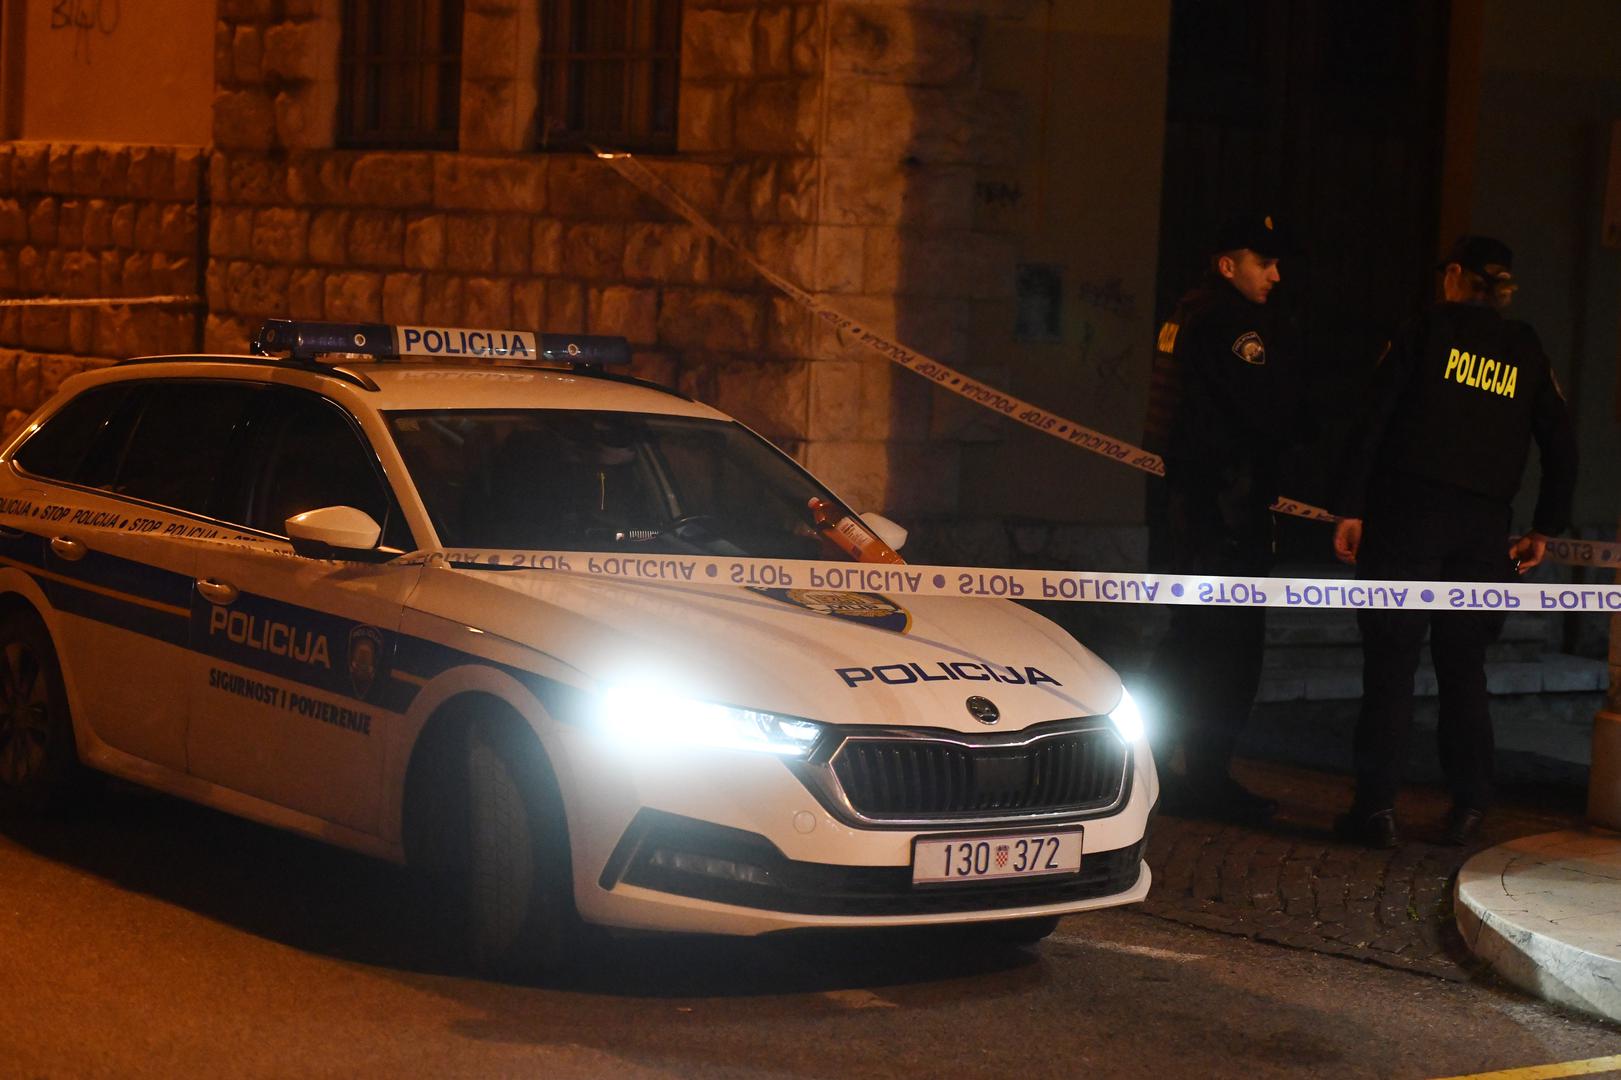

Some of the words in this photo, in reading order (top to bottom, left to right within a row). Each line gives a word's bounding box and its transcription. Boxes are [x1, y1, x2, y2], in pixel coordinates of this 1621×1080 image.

[404, 329, 528, 357] POLICIJA
[915, 363, 949, 381] STOP
[1444, 347, 1518, 399] POLICIJA
[960, 382, 1017, 413] POLICIJA
[1019, 411, 1056, 429] STOP
[1068, 429, 1131, 458] POLICIJA
[40, 506, 70, 521] STOP
[73, 510, 117, 529] POLICIJA
[128, 518, 162, 533] STOP
[209, 605, 332, 669] POLICIJA
[835, 662, 1063, 687] POLICIJA
[209, 668, 279, 706] SIGURNOST
[280, 690, 286, 709] I
[288, 692, 372, 736] POVJERENJE
[944, 842, 991, 877] 130
[1013, 837, 1060, 872] 372
